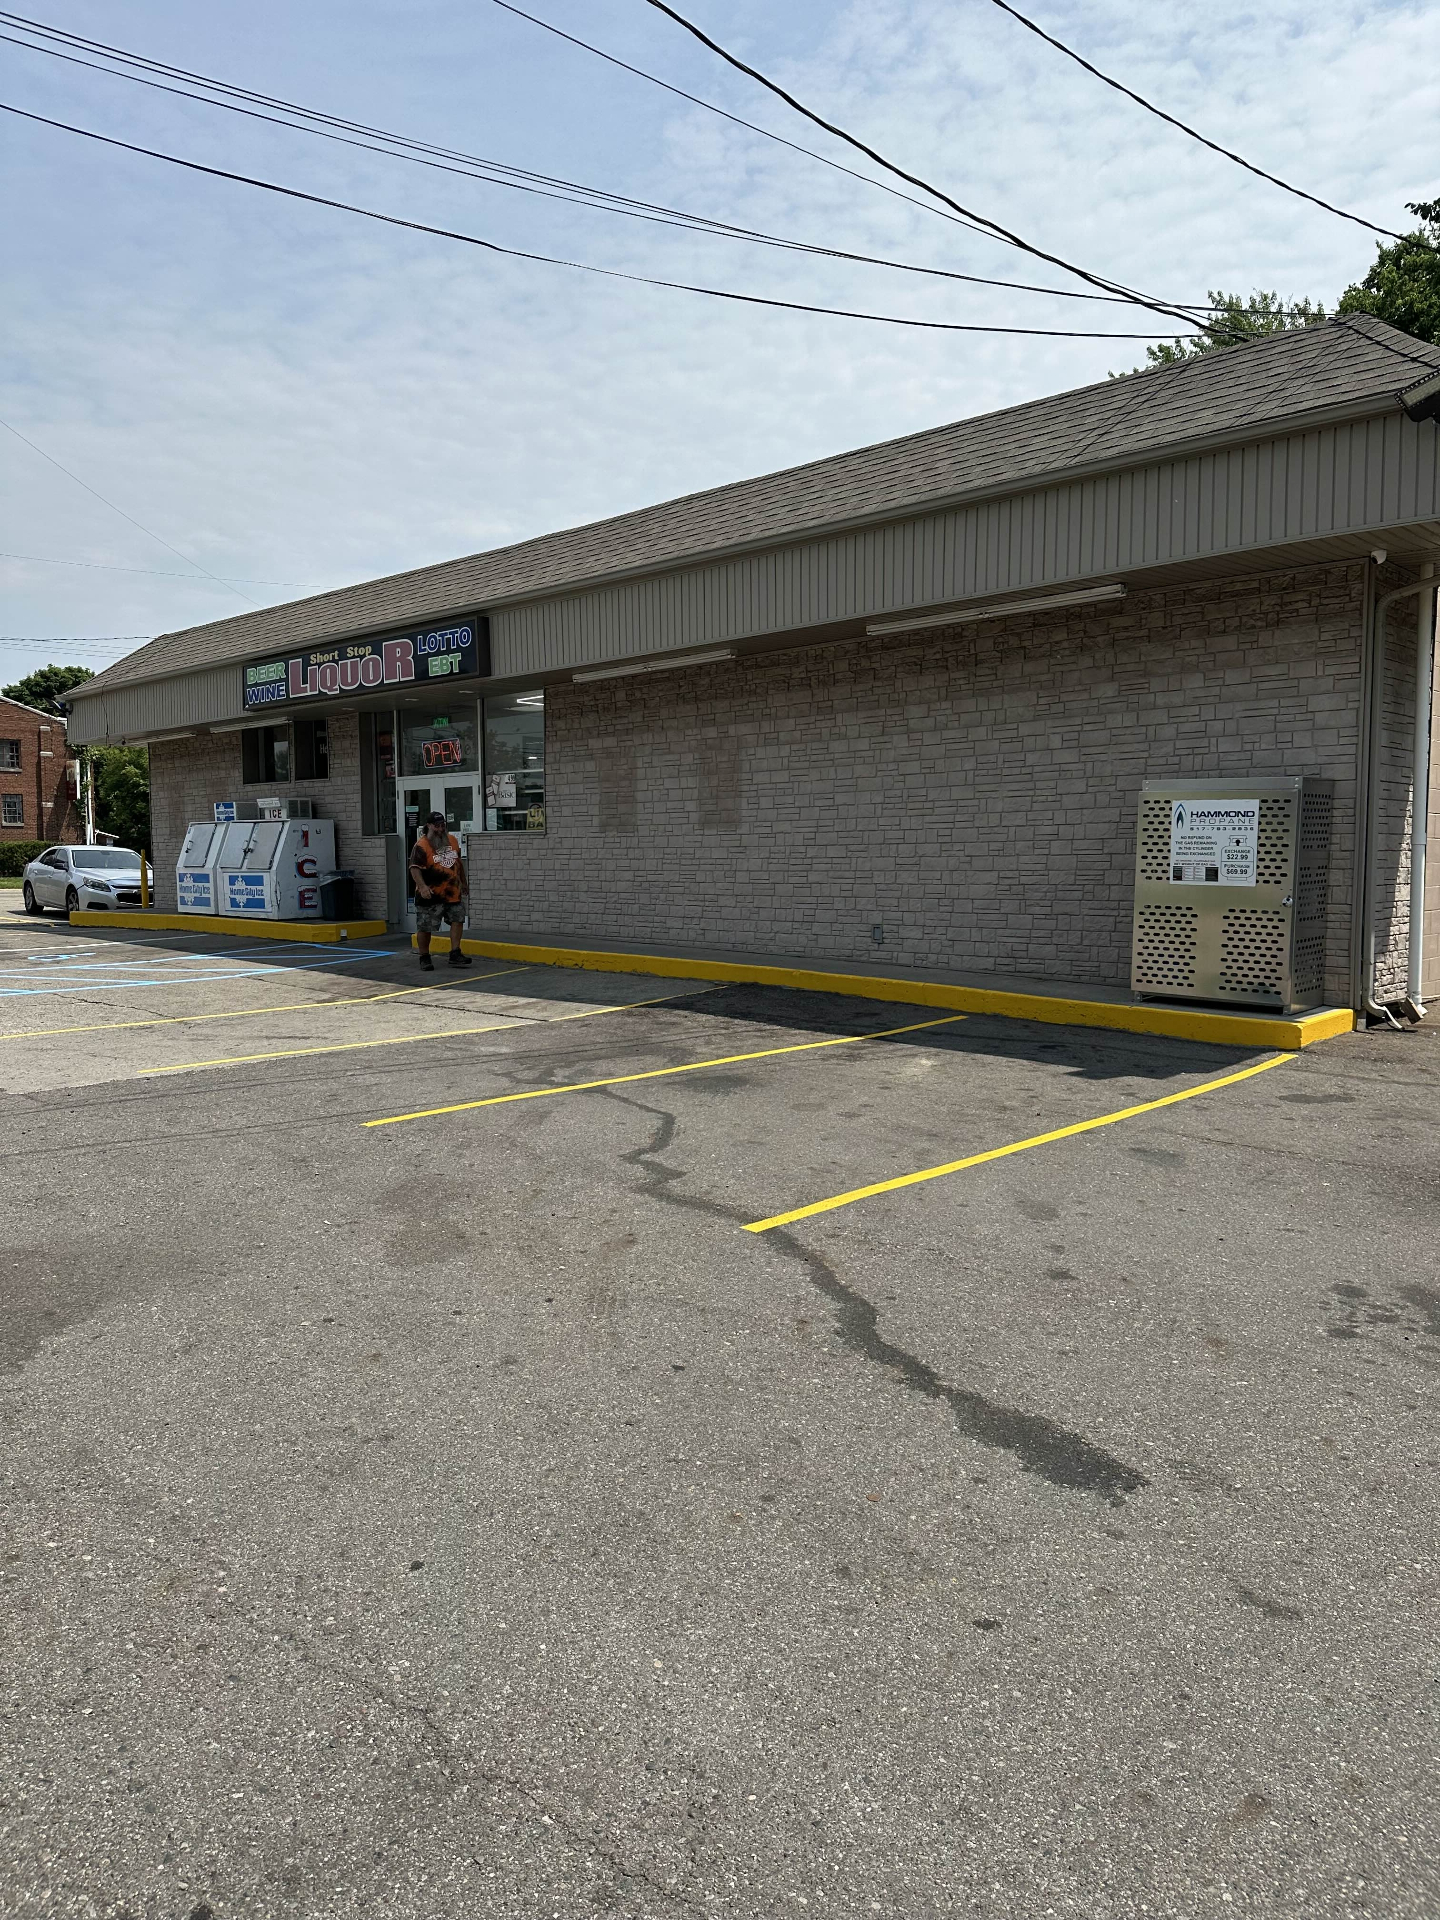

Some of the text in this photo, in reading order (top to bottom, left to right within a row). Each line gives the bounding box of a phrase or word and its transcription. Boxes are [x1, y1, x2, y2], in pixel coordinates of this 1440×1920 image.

[418, 626, 472, 654] LOTTO
[310, 646, 372, 664] Short Stop
[428, 653, 462, 676] EBT
[246, 662, 286, 684] BEER
[288, 638, 414, 698] LIQUOR
[246, 682, 286, 704] WINE
[424, 739, 461, 765] OPEN
[269, 809, 282, 818] ICE
[179, 884, 192, 894] Home
[203, 885, 211, 894] Ice
[229, 887, 245, 896] Home
[256, 888, 264, 896] Ice
